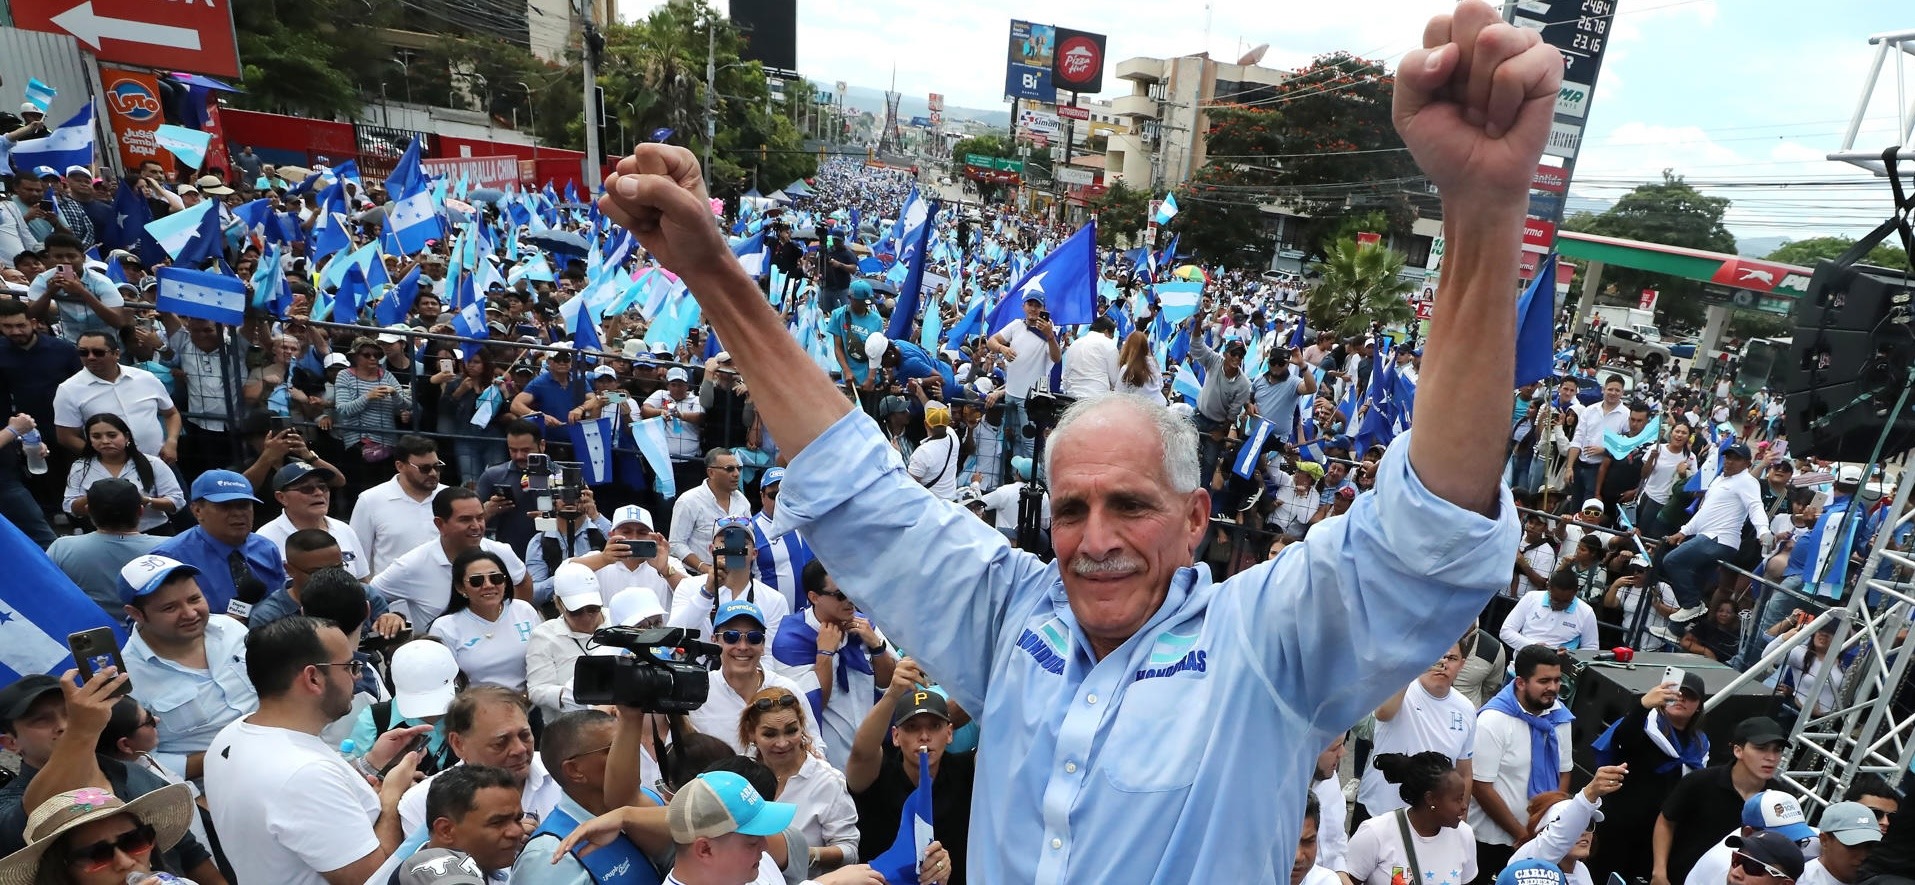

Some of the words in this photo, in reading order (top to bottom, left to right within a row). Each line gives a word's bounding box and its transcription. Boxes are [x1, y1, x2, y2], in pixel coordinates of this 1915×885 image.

[1065, 55, 1090, 66] Pizza
[1068, 64, 1088, 74] Hut
[497, 158, 518, 181] CHINA
[626, 507, 641, 521] H
[914, 692, 928, 706] P
[1514, 868, 1560, 881] CARLOS
